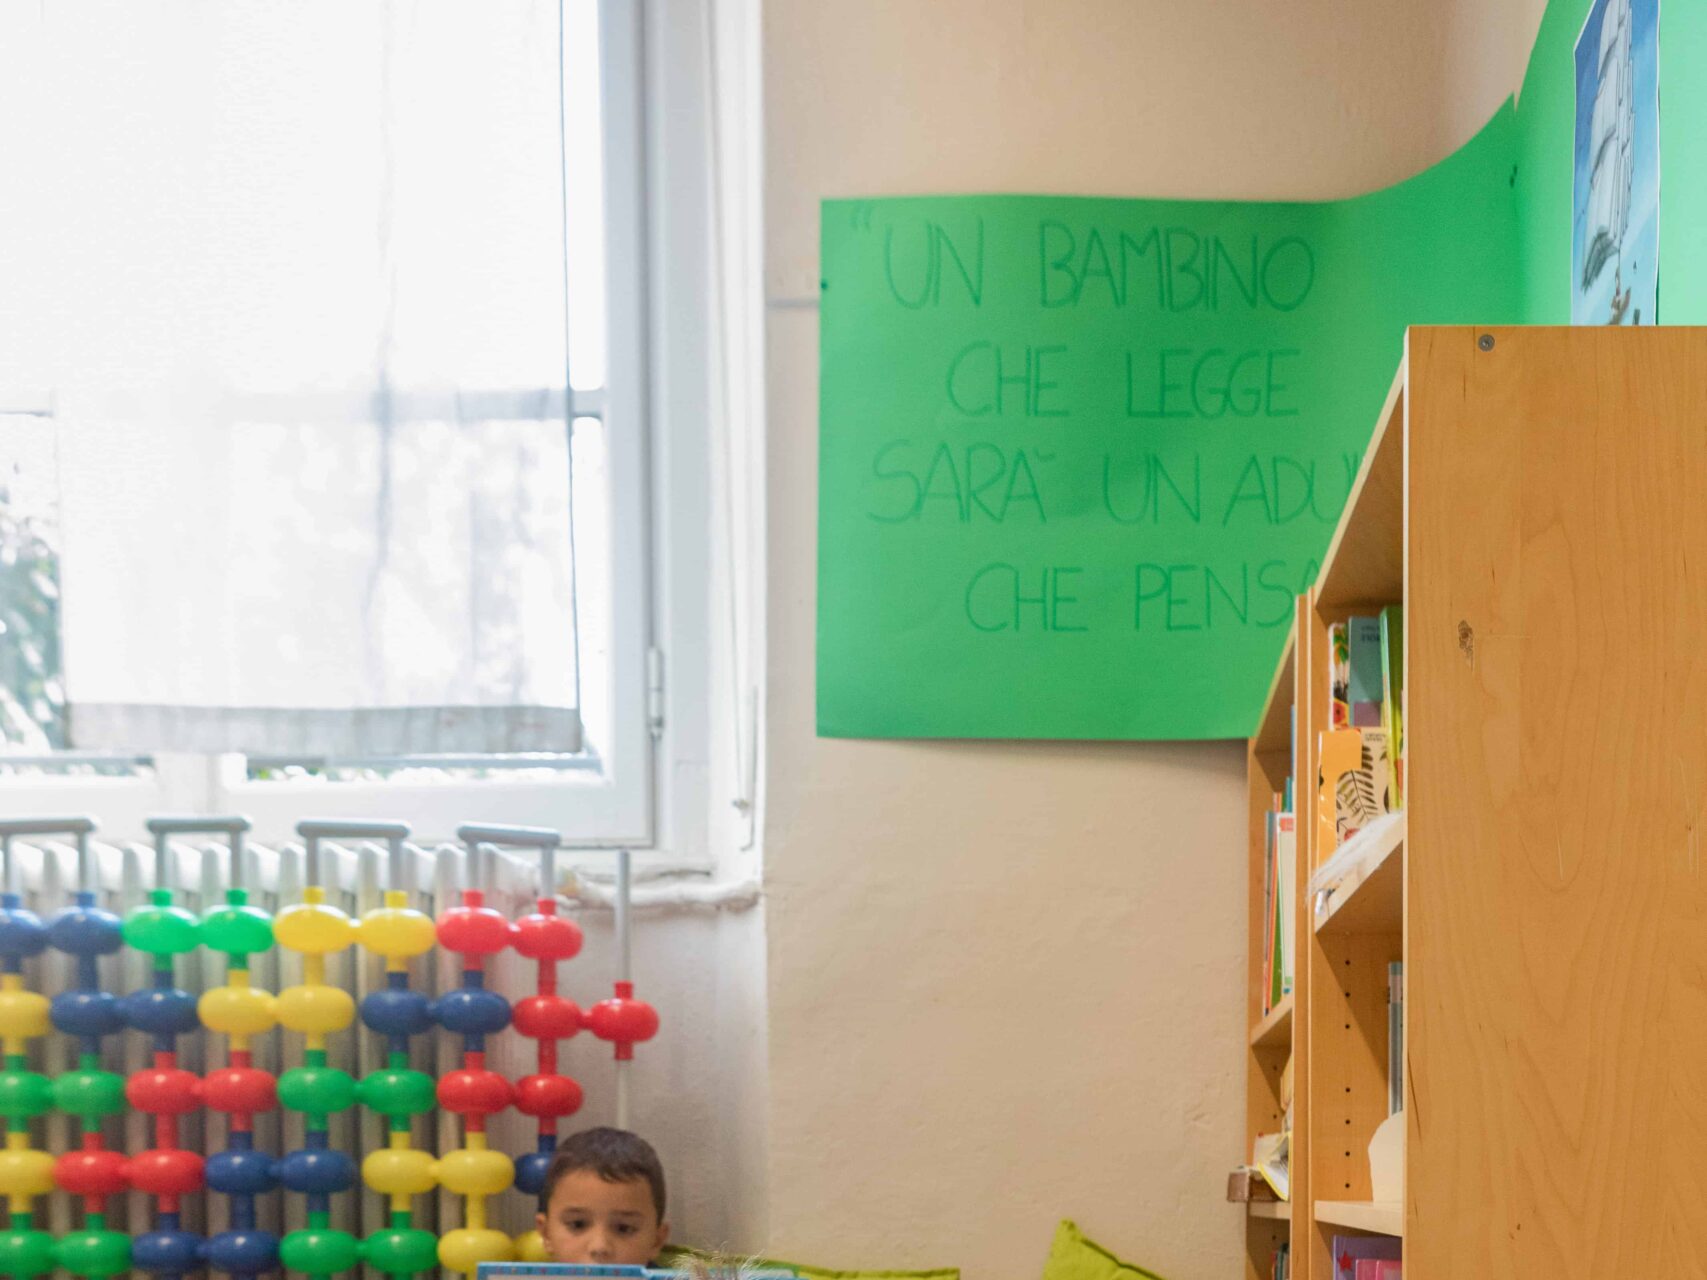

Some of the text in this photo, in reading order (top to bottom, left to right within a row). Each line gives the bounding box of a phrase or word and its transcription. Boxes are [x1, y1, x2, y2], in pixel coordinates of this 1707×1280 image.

[1039, 220, 1316, 312] BAMBINO
[946, 340, 1301, 419] CHE LEGGE
[1103, 453, 1202, 526] UN
[966, 563, 1088, 633] CHE
